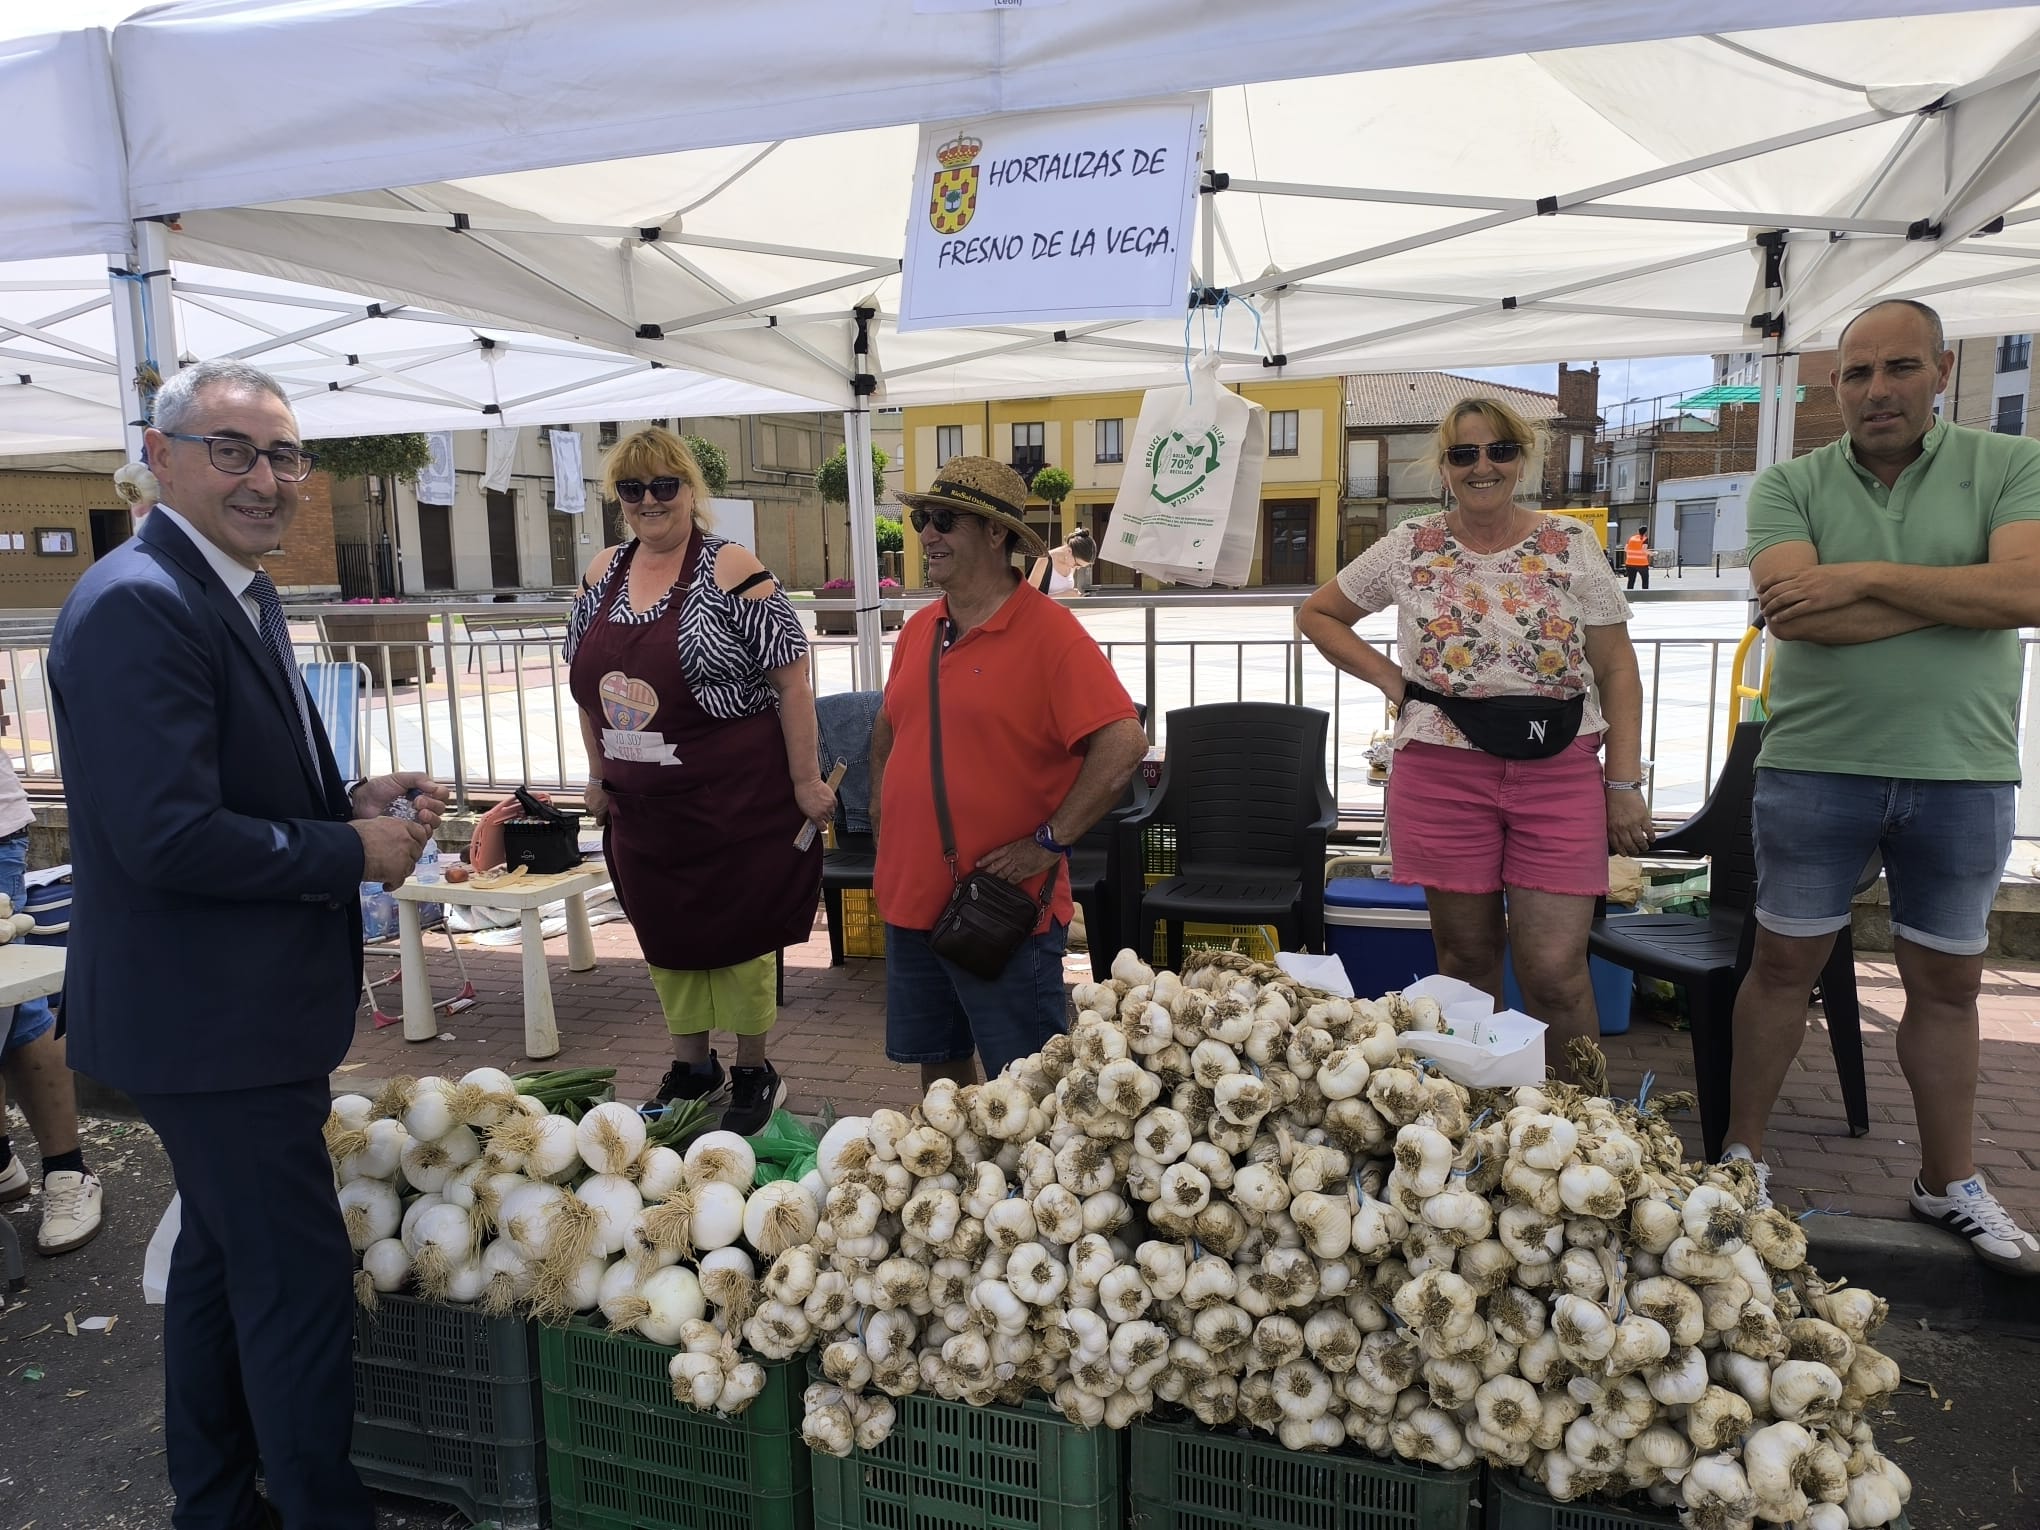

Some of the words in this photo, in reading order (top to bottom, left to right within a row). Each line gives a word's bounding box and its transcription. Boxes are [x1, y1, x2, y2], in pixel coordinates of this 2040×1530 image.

[989, 148, 1124, 186] HORTALIZAS
[1131, 147, 1167, 177] DE
[938, 233, 1024, 269] FRESNO
[1031, 230, 1064, 260] DE
[1071, 228, 1096, 258] LA
[1106, 225, 1176, 256] VEGA.
[1171, 459, 1194, 470] 70%
[1170, 485, 1206, 508] RECICLA
[615, 732, 625, 745] YO
[627, 733, 642, 746] SOY
